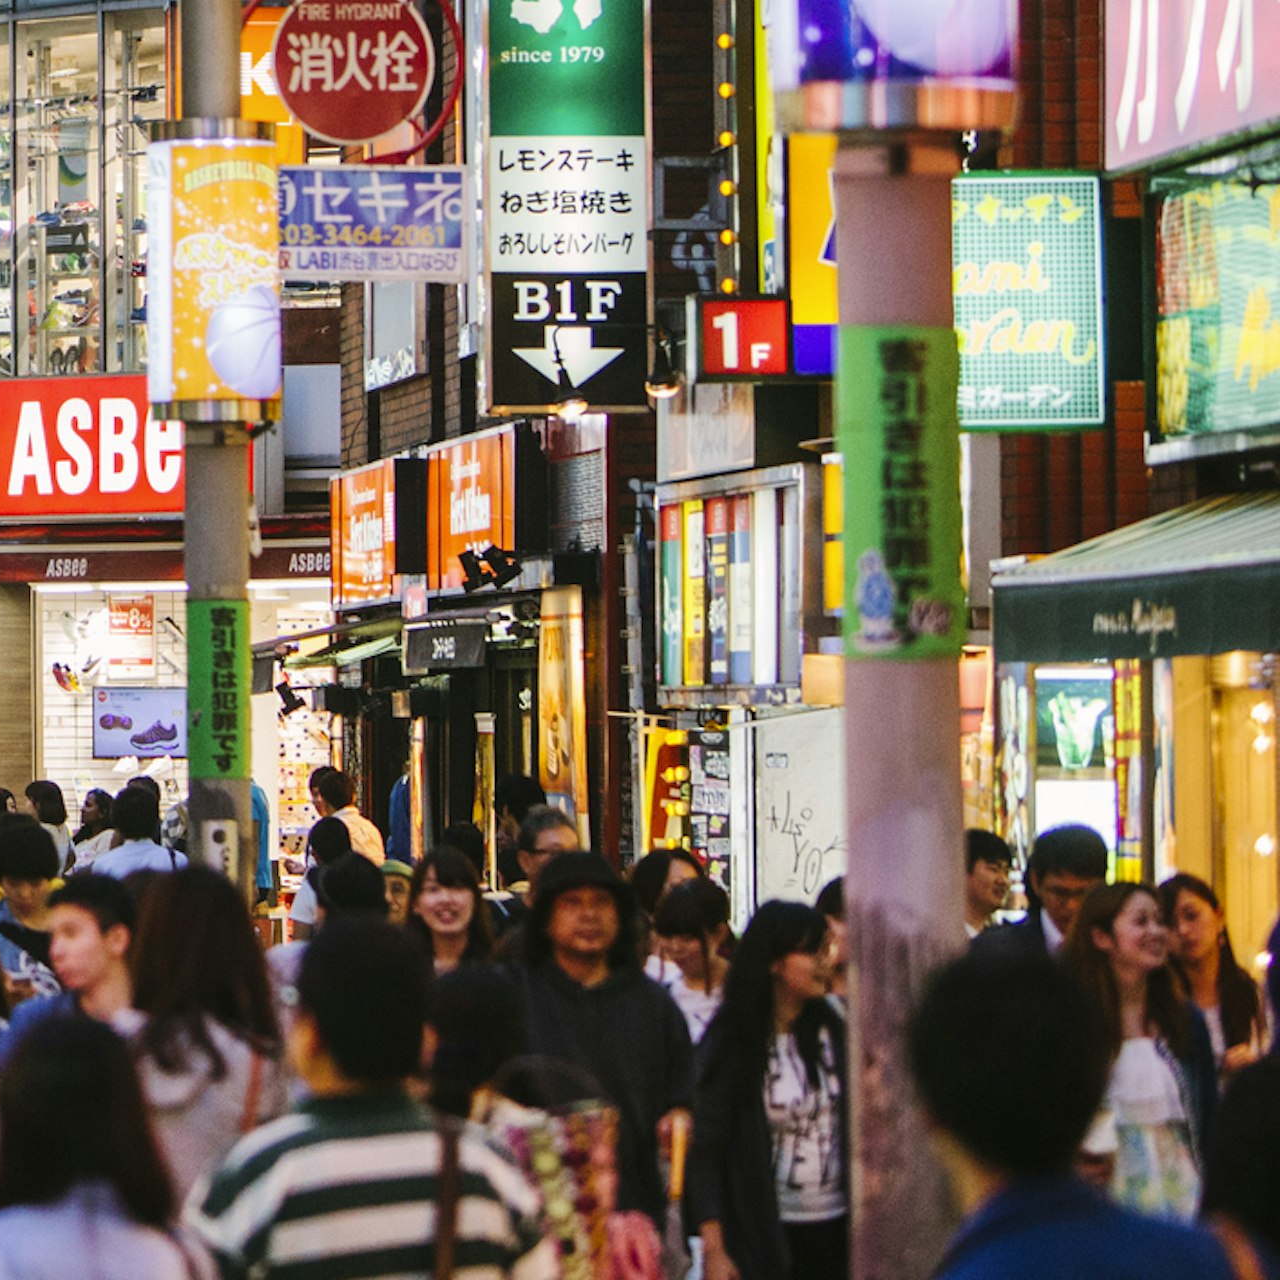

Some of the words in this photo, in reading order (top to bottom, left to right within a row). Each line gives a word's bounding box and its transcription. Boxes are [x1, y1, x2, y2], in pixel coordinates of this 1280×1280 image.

[298, 2, 332, 22] FIRE
[334, 1, 403, 22] HYDRANT
[286, 31, 419, 93] 消火栓
[500, 47, 552, 64] since
[559, 46, 605, 65] 1979
[497, 148, 635, 172] レモンステーキ
[500, 191, 633, 215] ねぎ塩焼き
[285, 224, 445, 246] 03-3464-2061
[497, 231, 634, 255] おろししそハンバーグ
[512, 280, 623, 322] B1F
[46, 557, 89, 578] ASBee
